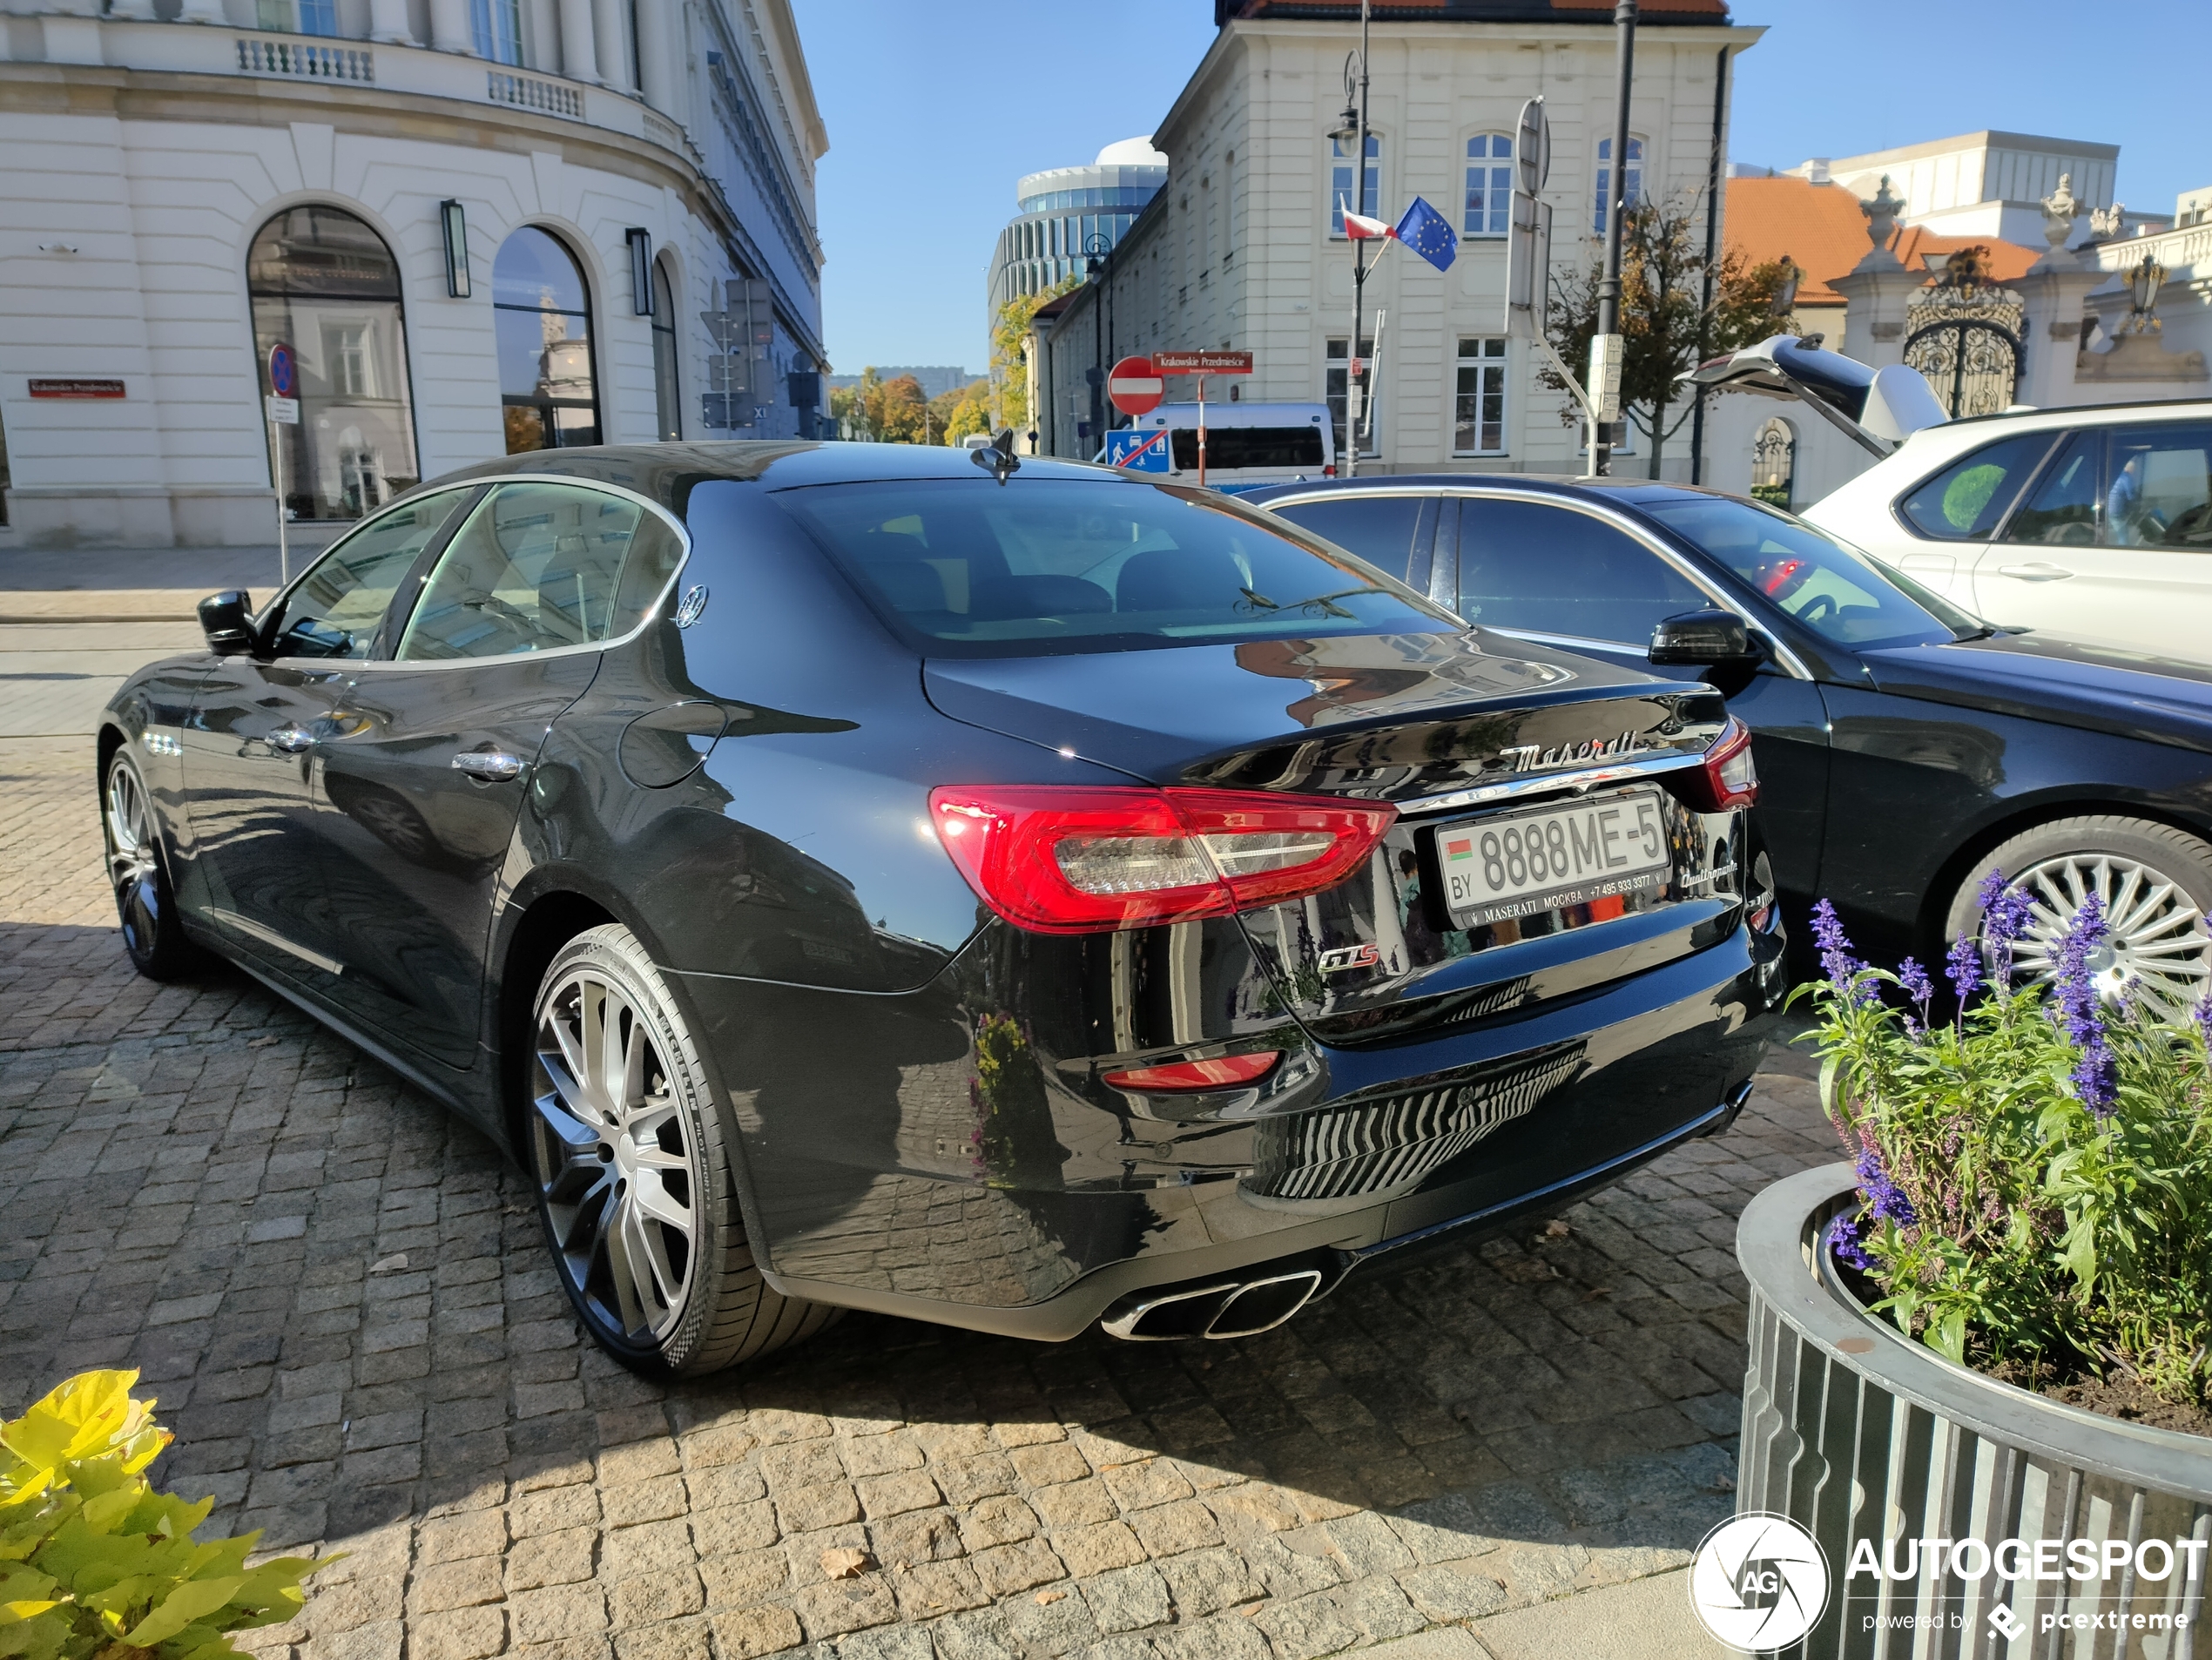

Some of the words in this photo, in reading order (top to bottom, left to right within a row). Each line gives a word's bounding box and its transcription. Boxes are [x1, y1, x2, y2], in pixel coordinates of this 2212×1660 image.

[1160, 356, 1199, 367] Krakowskie
[1201, 356, 1245, 367] Przedmieście
[1500, 730, 1649, 773] Maserati
[1450, 873, 1473, 901] BY
[1680, 860, 1738, 888] Quattroporte
[1484, 900, 1538, 923] MASERATI
[1589, 886, 1601, 897] +7
[1602, 882, 1617, 895] 495
[1617, 879, 1633, 892] 933
[1633, 874, 1650, 889] 3377
[1317, 943, 1379, 974] GTS
[658, 1016, 698, 1111] MICHELIN
[695, 1122, 705, 1152] PILOT
[701, 1157, 711, 1193] SPORT
